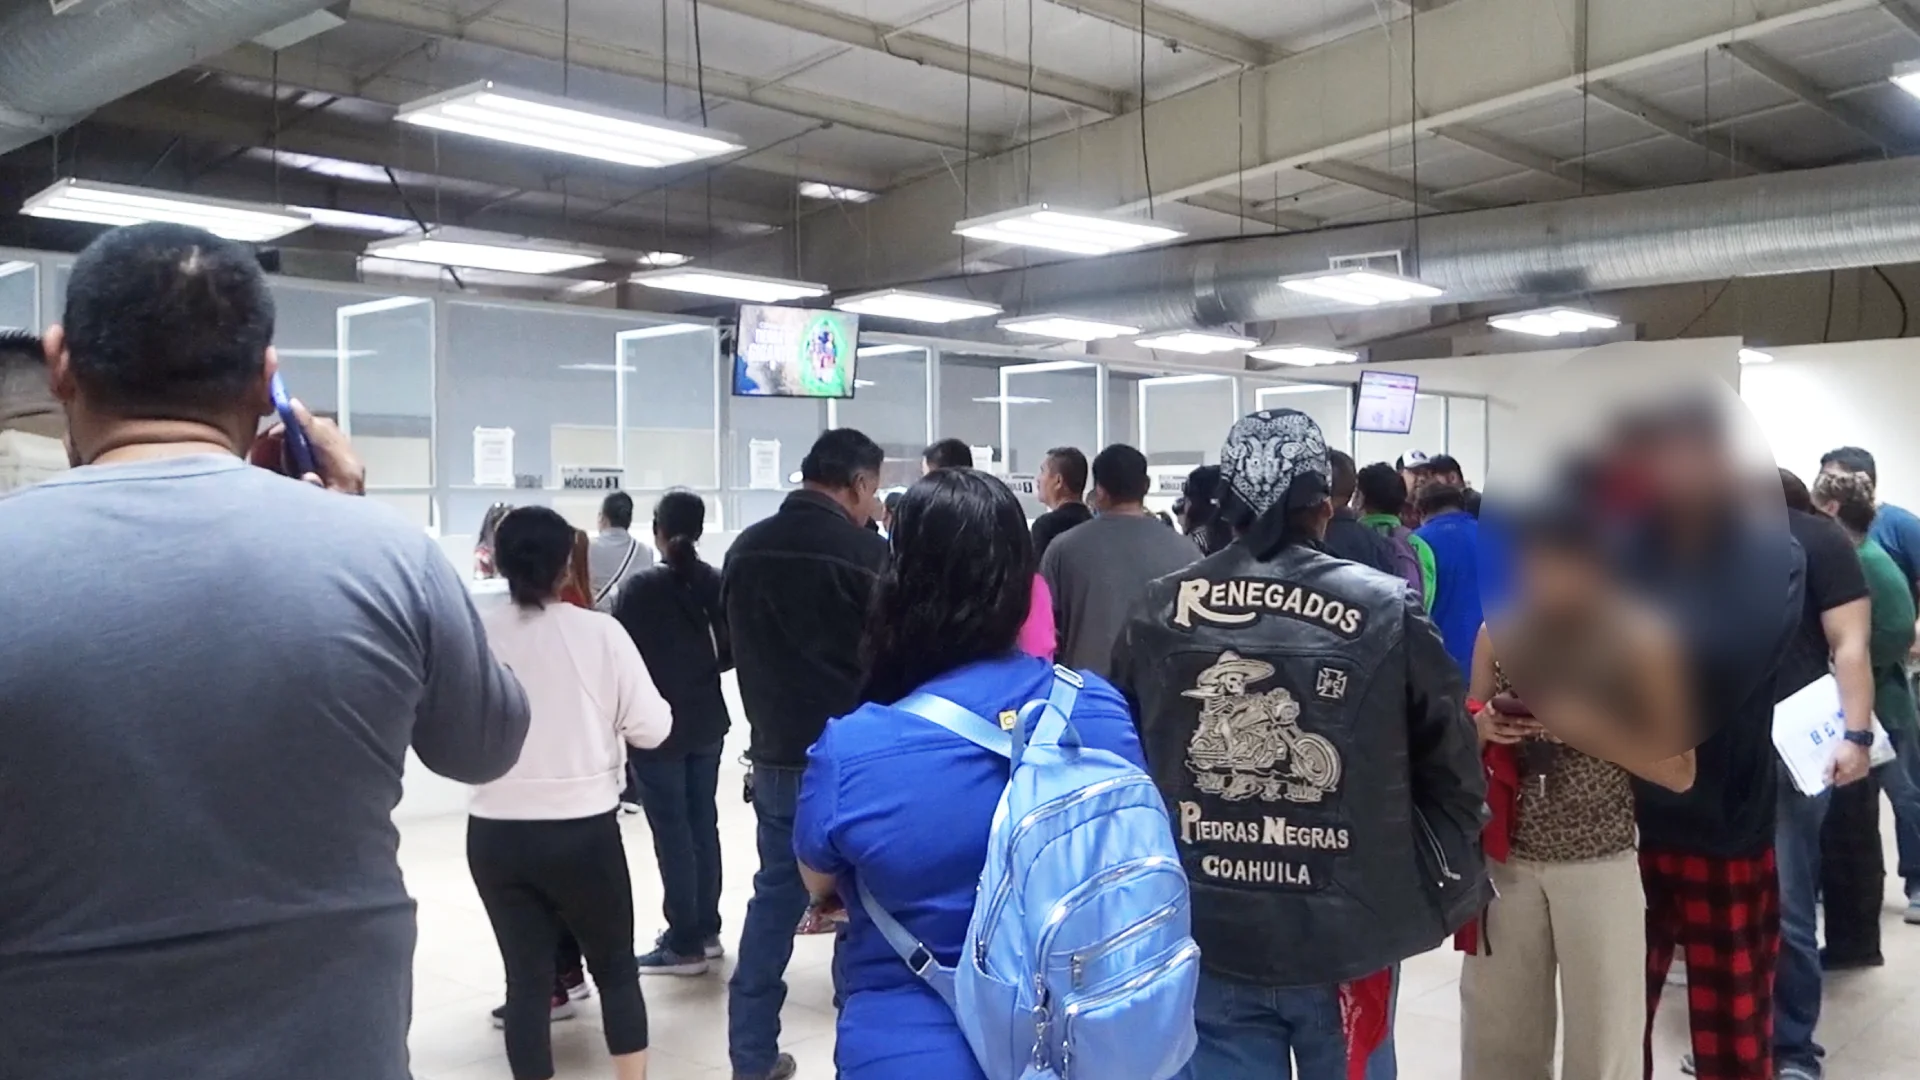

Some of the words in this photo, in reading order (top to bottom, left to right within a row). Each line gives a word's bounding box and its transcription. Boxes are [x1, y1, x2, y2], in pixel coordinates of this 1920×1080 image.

[564, 475, 603, 489] MÓDULO
[1174, 578, 1362, 633] RENEGADOS
[1178, 800, 1260, 844] PIEDRAS
[1262, 816, 1350, 849] NEGRAS
[1202, 855, 1312, 885] COAHUILA
